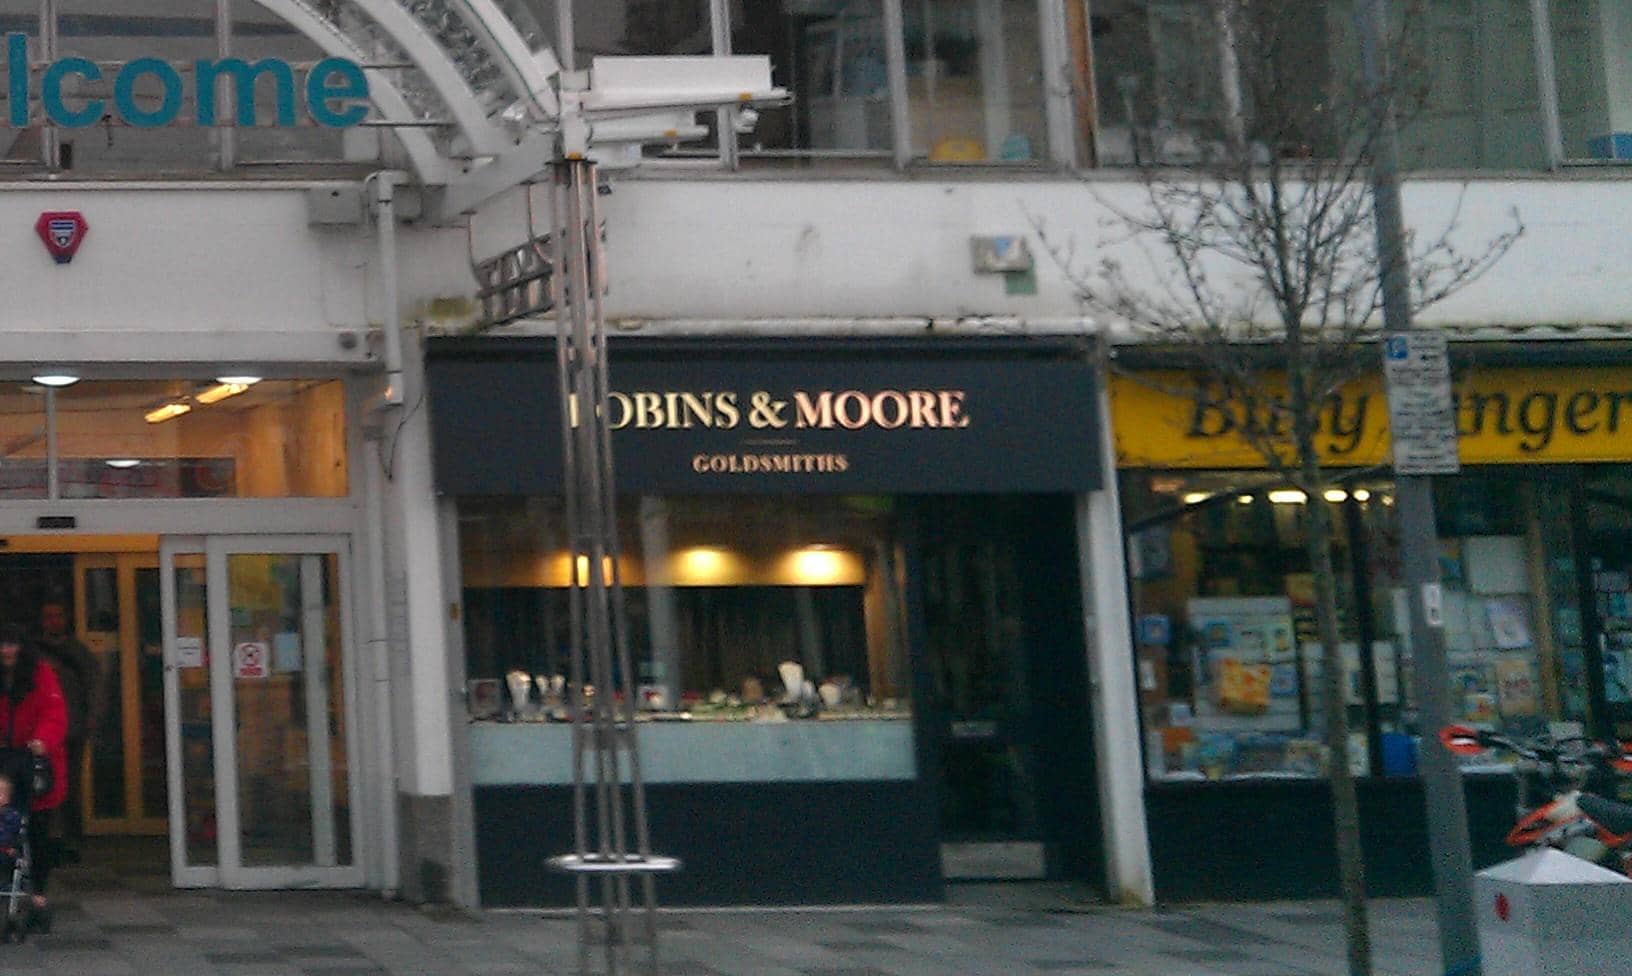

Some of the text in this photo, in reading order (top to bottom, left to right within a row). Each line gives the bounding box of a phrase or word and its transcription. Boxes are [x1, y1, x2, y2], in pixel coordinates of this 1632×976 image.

[748, 390, 788, 429] &
[793, 389, 970, 430] MOORE
[692, 453, 850, 474] GOLDSMITHS
